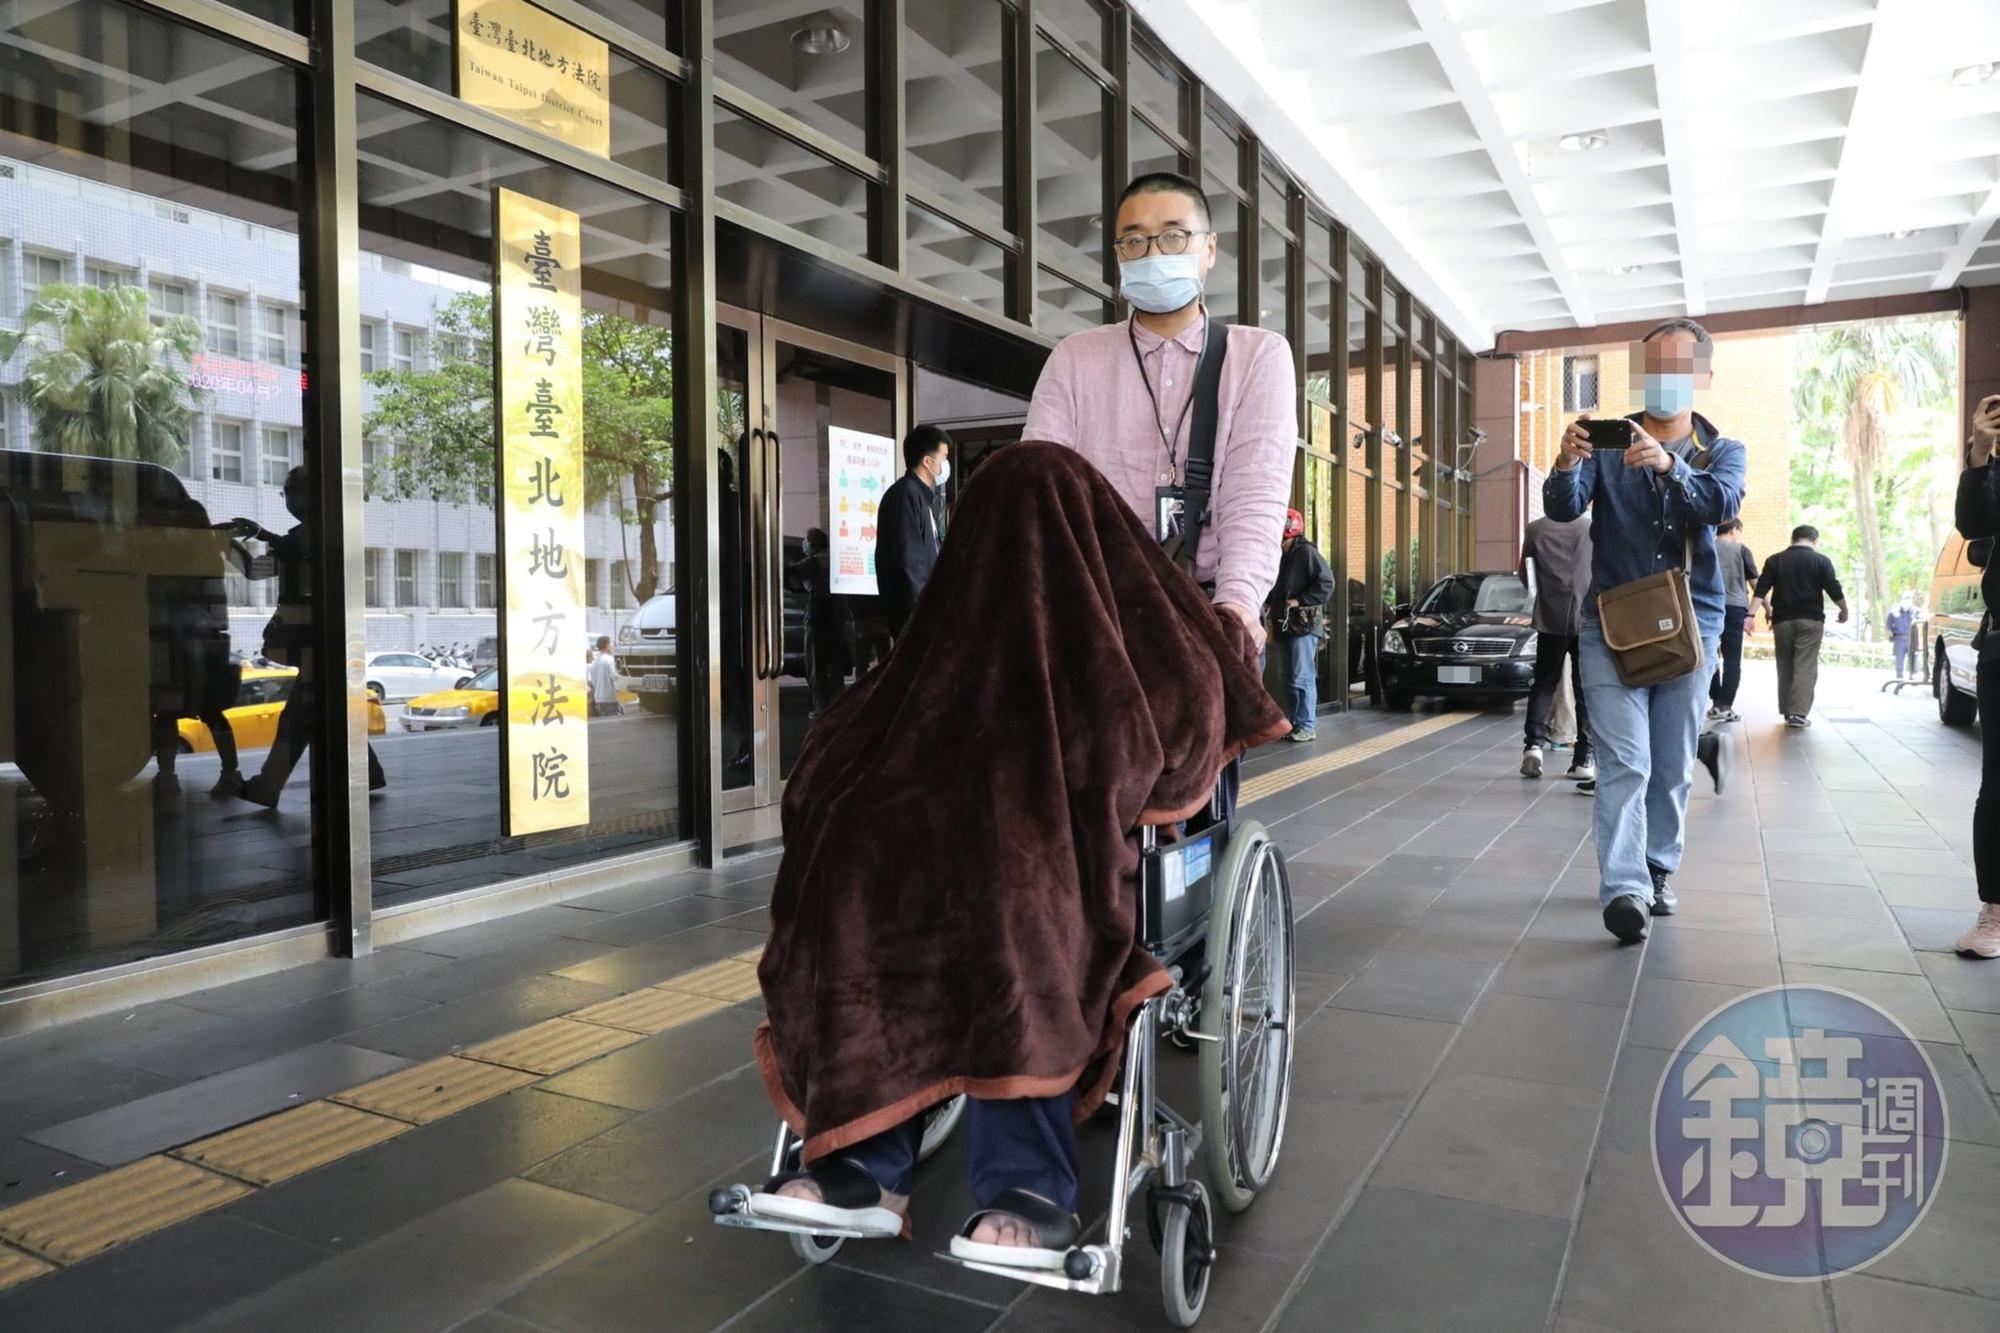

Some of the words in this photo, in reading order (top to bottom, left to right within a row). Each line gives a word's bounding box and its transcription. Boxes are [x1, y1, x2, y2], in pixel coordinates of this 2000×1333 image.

[469, 12, 601, 91] 臺灣臺北地方法院
[469, 60, 504, 84] Taiwan
[508, 78, 537, 99] Taipei
[541, 93, 575, 115] District
[578, 109, 603, 127] Court
[524, 229, 569, 801] 臺灣臺北地方法院
